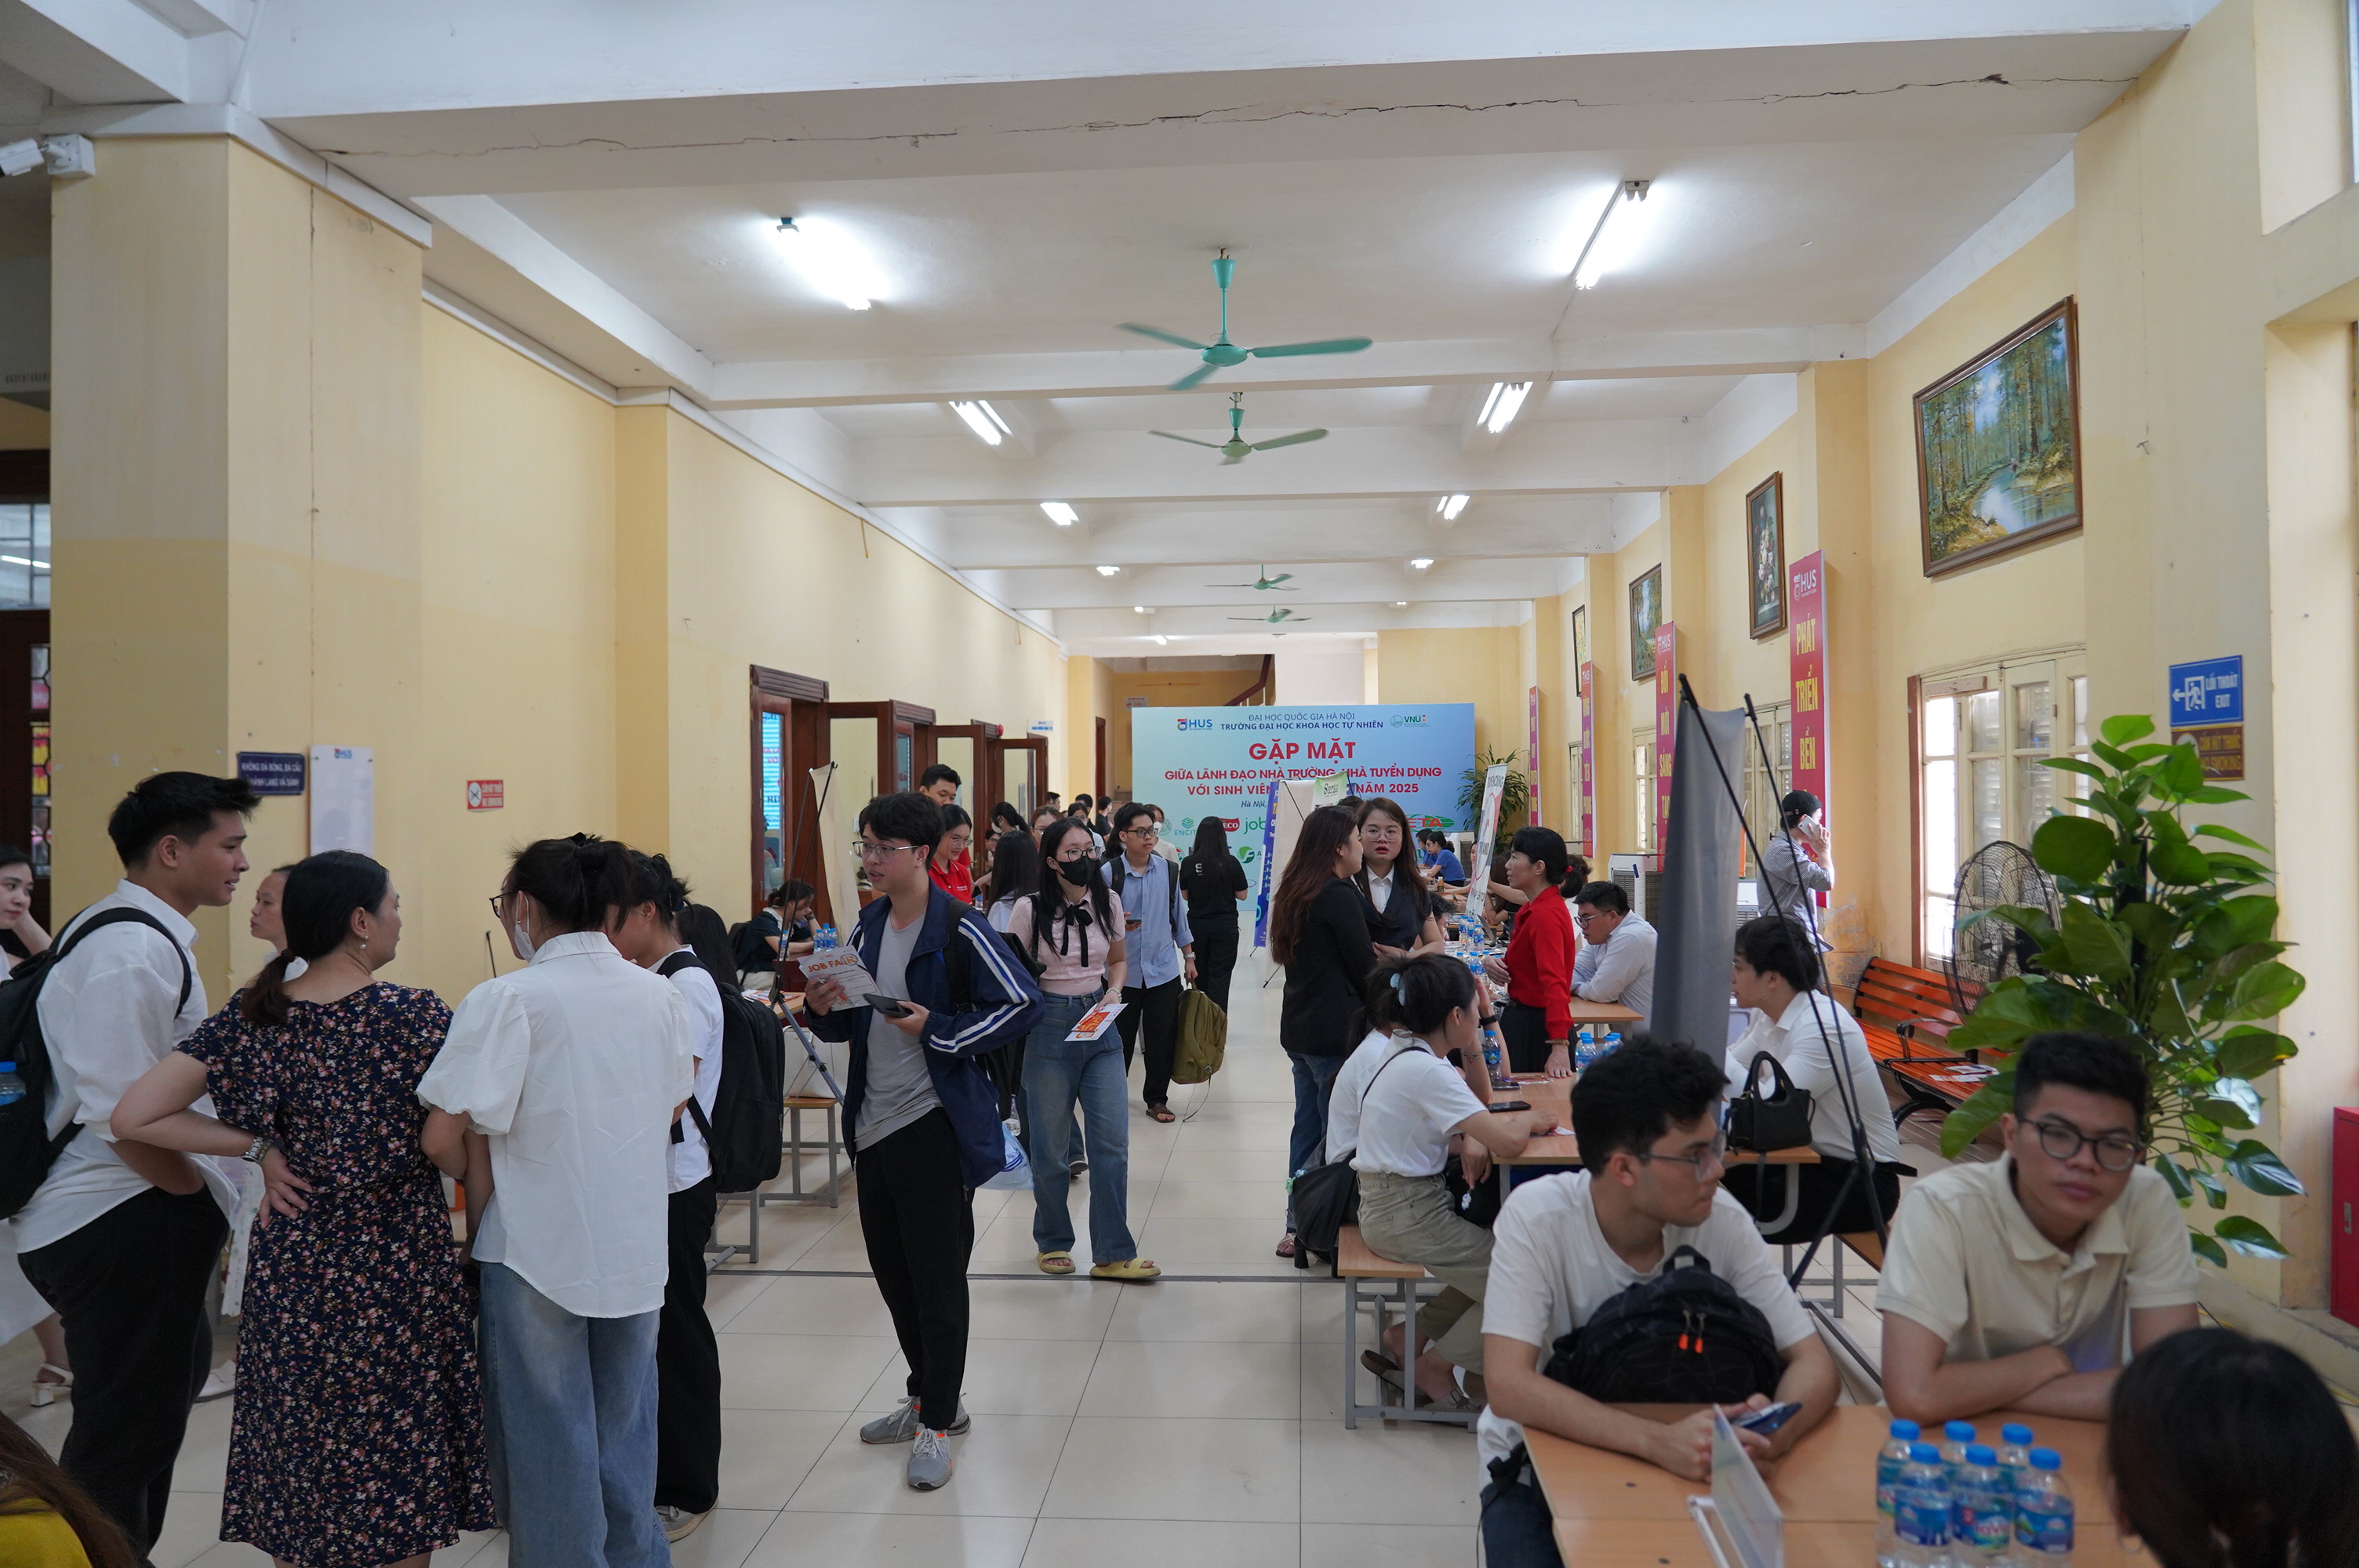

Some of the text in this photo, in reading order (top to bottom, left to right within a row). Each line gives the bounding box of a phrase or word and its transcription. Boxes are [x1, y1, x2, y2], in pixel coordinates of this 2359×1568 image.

[1801, 568, 1817, 593] HUS
[1796, 612, 1816, 655] PHÁT
[1795, 664, 1819, 713] TRIỂN
[2215, 694, 2231, 709] EXIT
[1189, 719, 1213, 728] HUS
[1264, 713, 1282, 722] HỌC
[1284, 712, 1308, 722] QUỐC
[1326, 712, 1338, 720] HÀ
[1339, 711, 1355, 720] NỘI
[1220, 721, 1257, 731] TRƯỜNG
[1259, 722, 1274, 731] ĐẠI
[1276, 722, 1294, 731] HỌC
[1321, 721, 1339, 731] HỌC
[1342, 720, 1355, 731] TỰ
[1356, 720, 1383, 729] NHIÊN
[1249, 737, 1356, 764] GẶP MẶT
[1165, 768, 1194, 780] GIỮA
[1197, 768, 1227, 780] LÃNH
[1230, 770, 1257, 782] ĐẠO
[1259, 766, 1285, 779] NHÀ
[1369, 762, 1405, 778] TUYỂN
[1407, 767, 1442, 780] DỤNG
[1187, 783, 1210, 796] VỚI
[1213, 785, 1243, 796] SINH
[1355, 782, 1385, 793] NĂM
[1389, 783, 1419, 793] 2025
[1253, 800, 1267, 809] Nội,
[808, 963, 827, 973] JOB
[828, 956, 856, 968] FAIR
